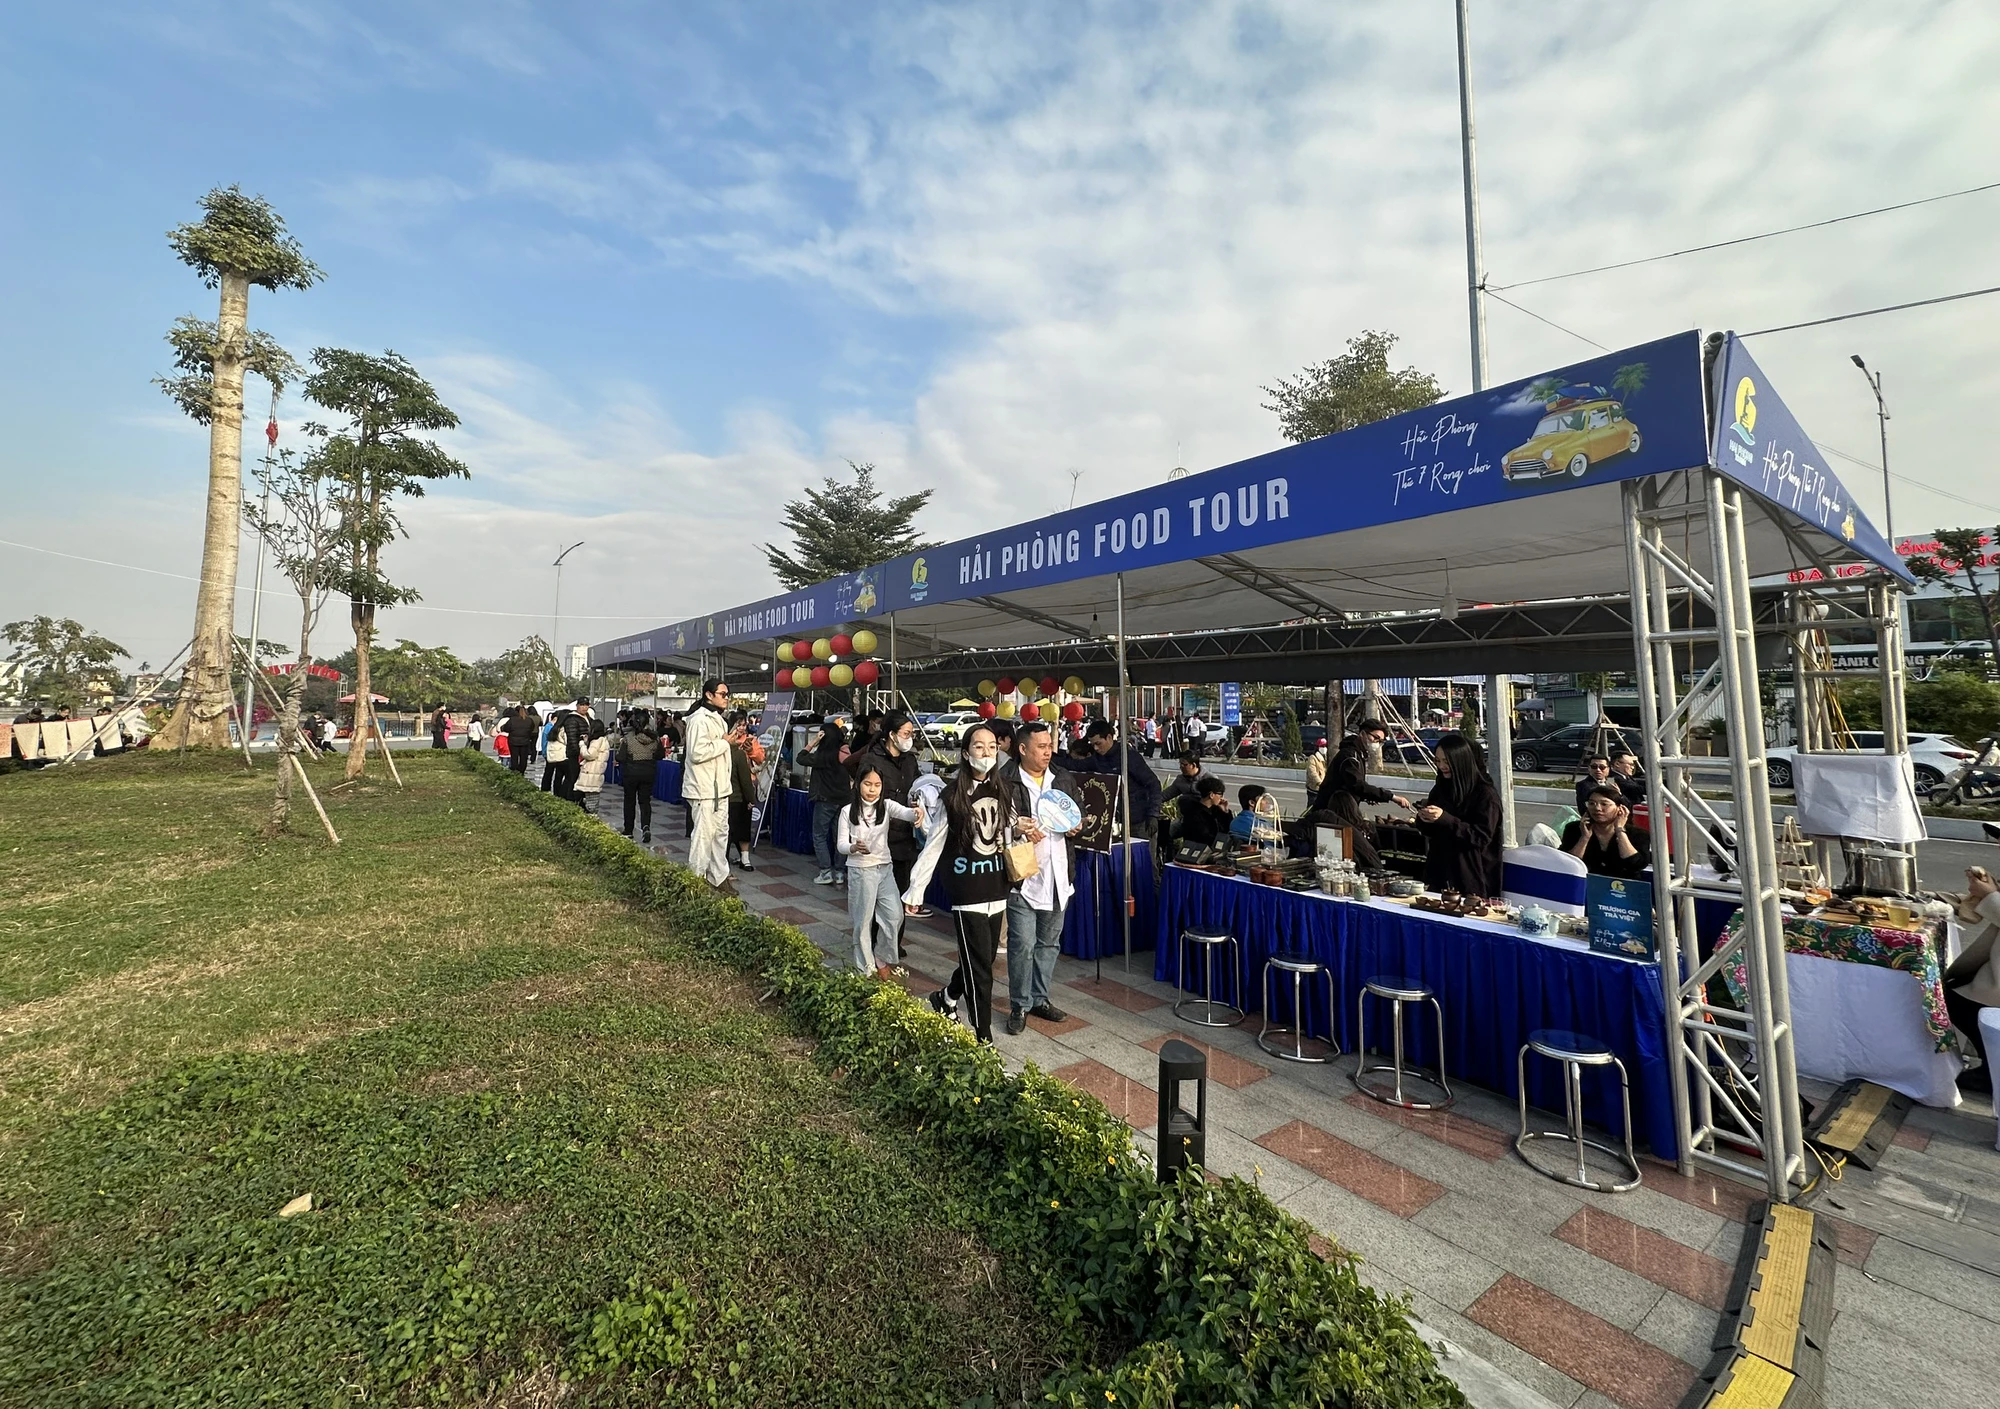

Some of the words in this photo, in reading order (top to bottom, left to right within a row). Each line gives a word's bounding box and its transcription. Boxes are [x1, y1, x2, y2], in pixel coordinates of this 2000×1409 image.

[1431, 413, 1479, 455] Phòng
[1418, 465, 1427, 484] 7
[1430, 461, 1464, 494] Rong
[959, 543, 992, 585] HẢI
[1001, 530, 1080, 576] PHÒNG
[1094, 507, 1171, 558] FOOD
[1188, 477, 1289, 537] TOUR
[724, 614, 736, 637] HẢI
[738, 610, 763, 634] PHÒNG
[766, 605, 787, 629] FOOD
[790, 598, 815, 623] TOUR
[1872, 656, 1925, 667] QNG
